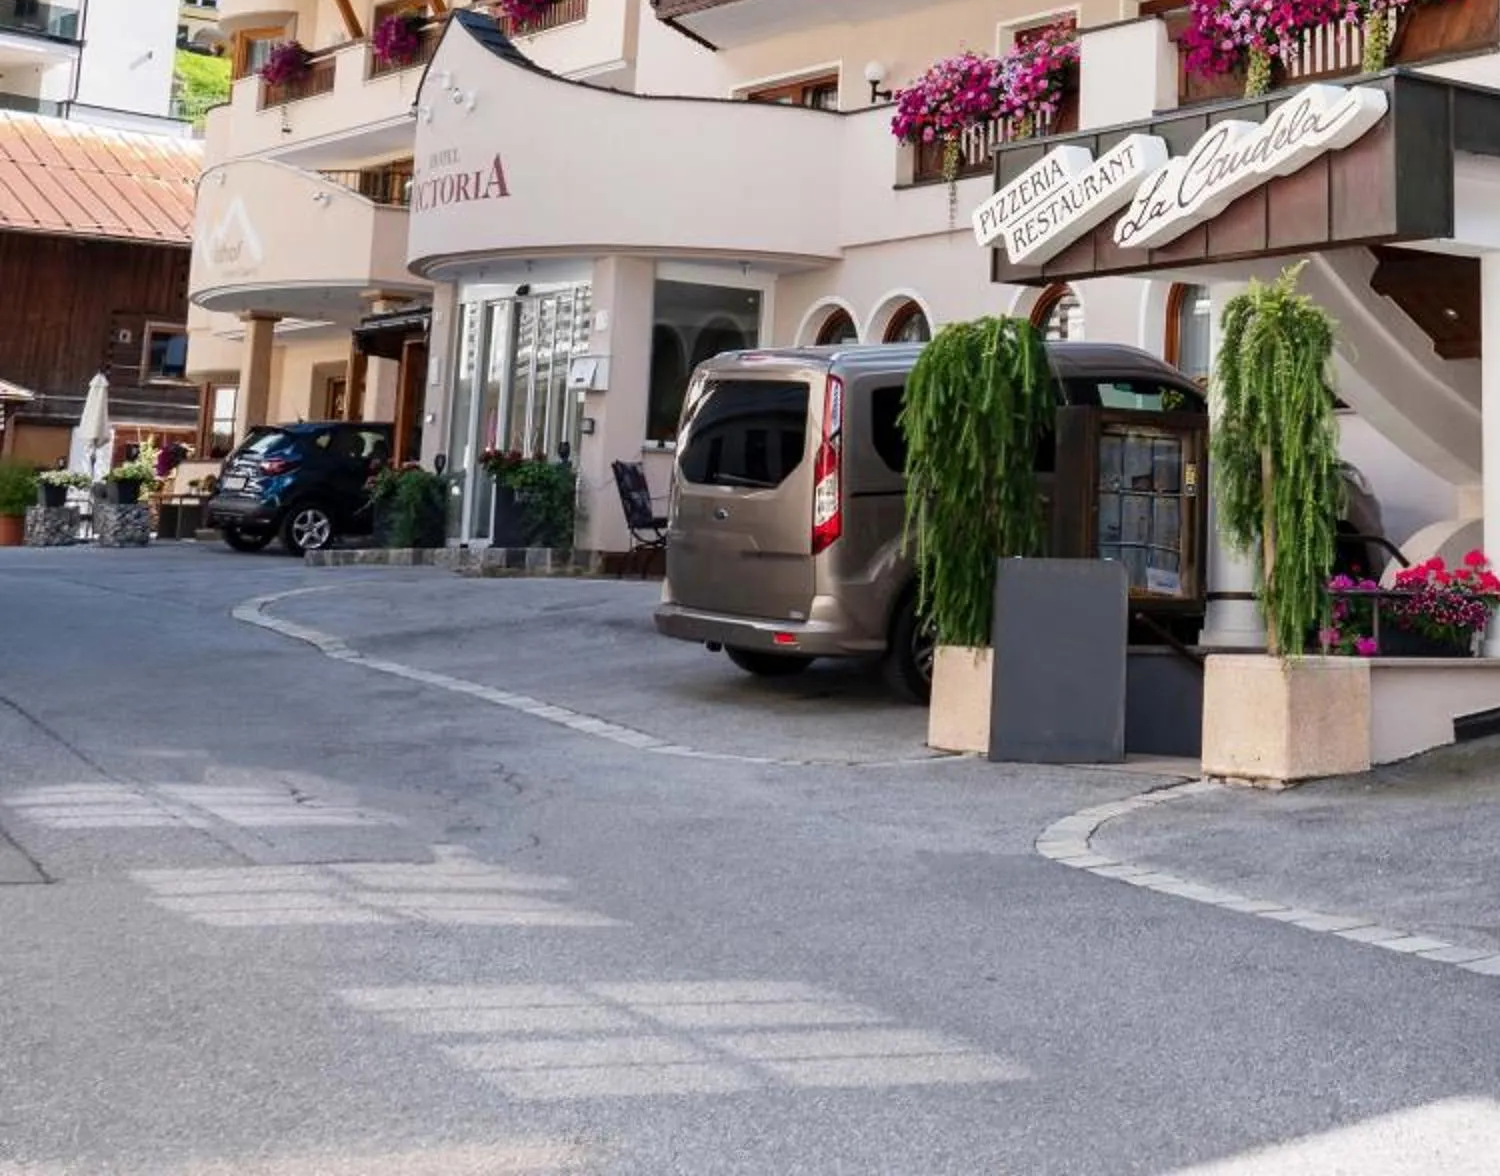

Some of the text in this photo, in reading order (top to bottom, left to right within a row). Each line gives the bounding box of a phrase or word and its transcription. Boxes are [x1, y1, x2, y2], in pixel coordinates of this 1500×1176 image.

[411, 152, 511, 214] ICTORIA
[979, 159, 1064, 235] PIZZERIA
[1013, 145, 1136, 252] RESTAURANT
[1119, 170, 1174, 242] La
